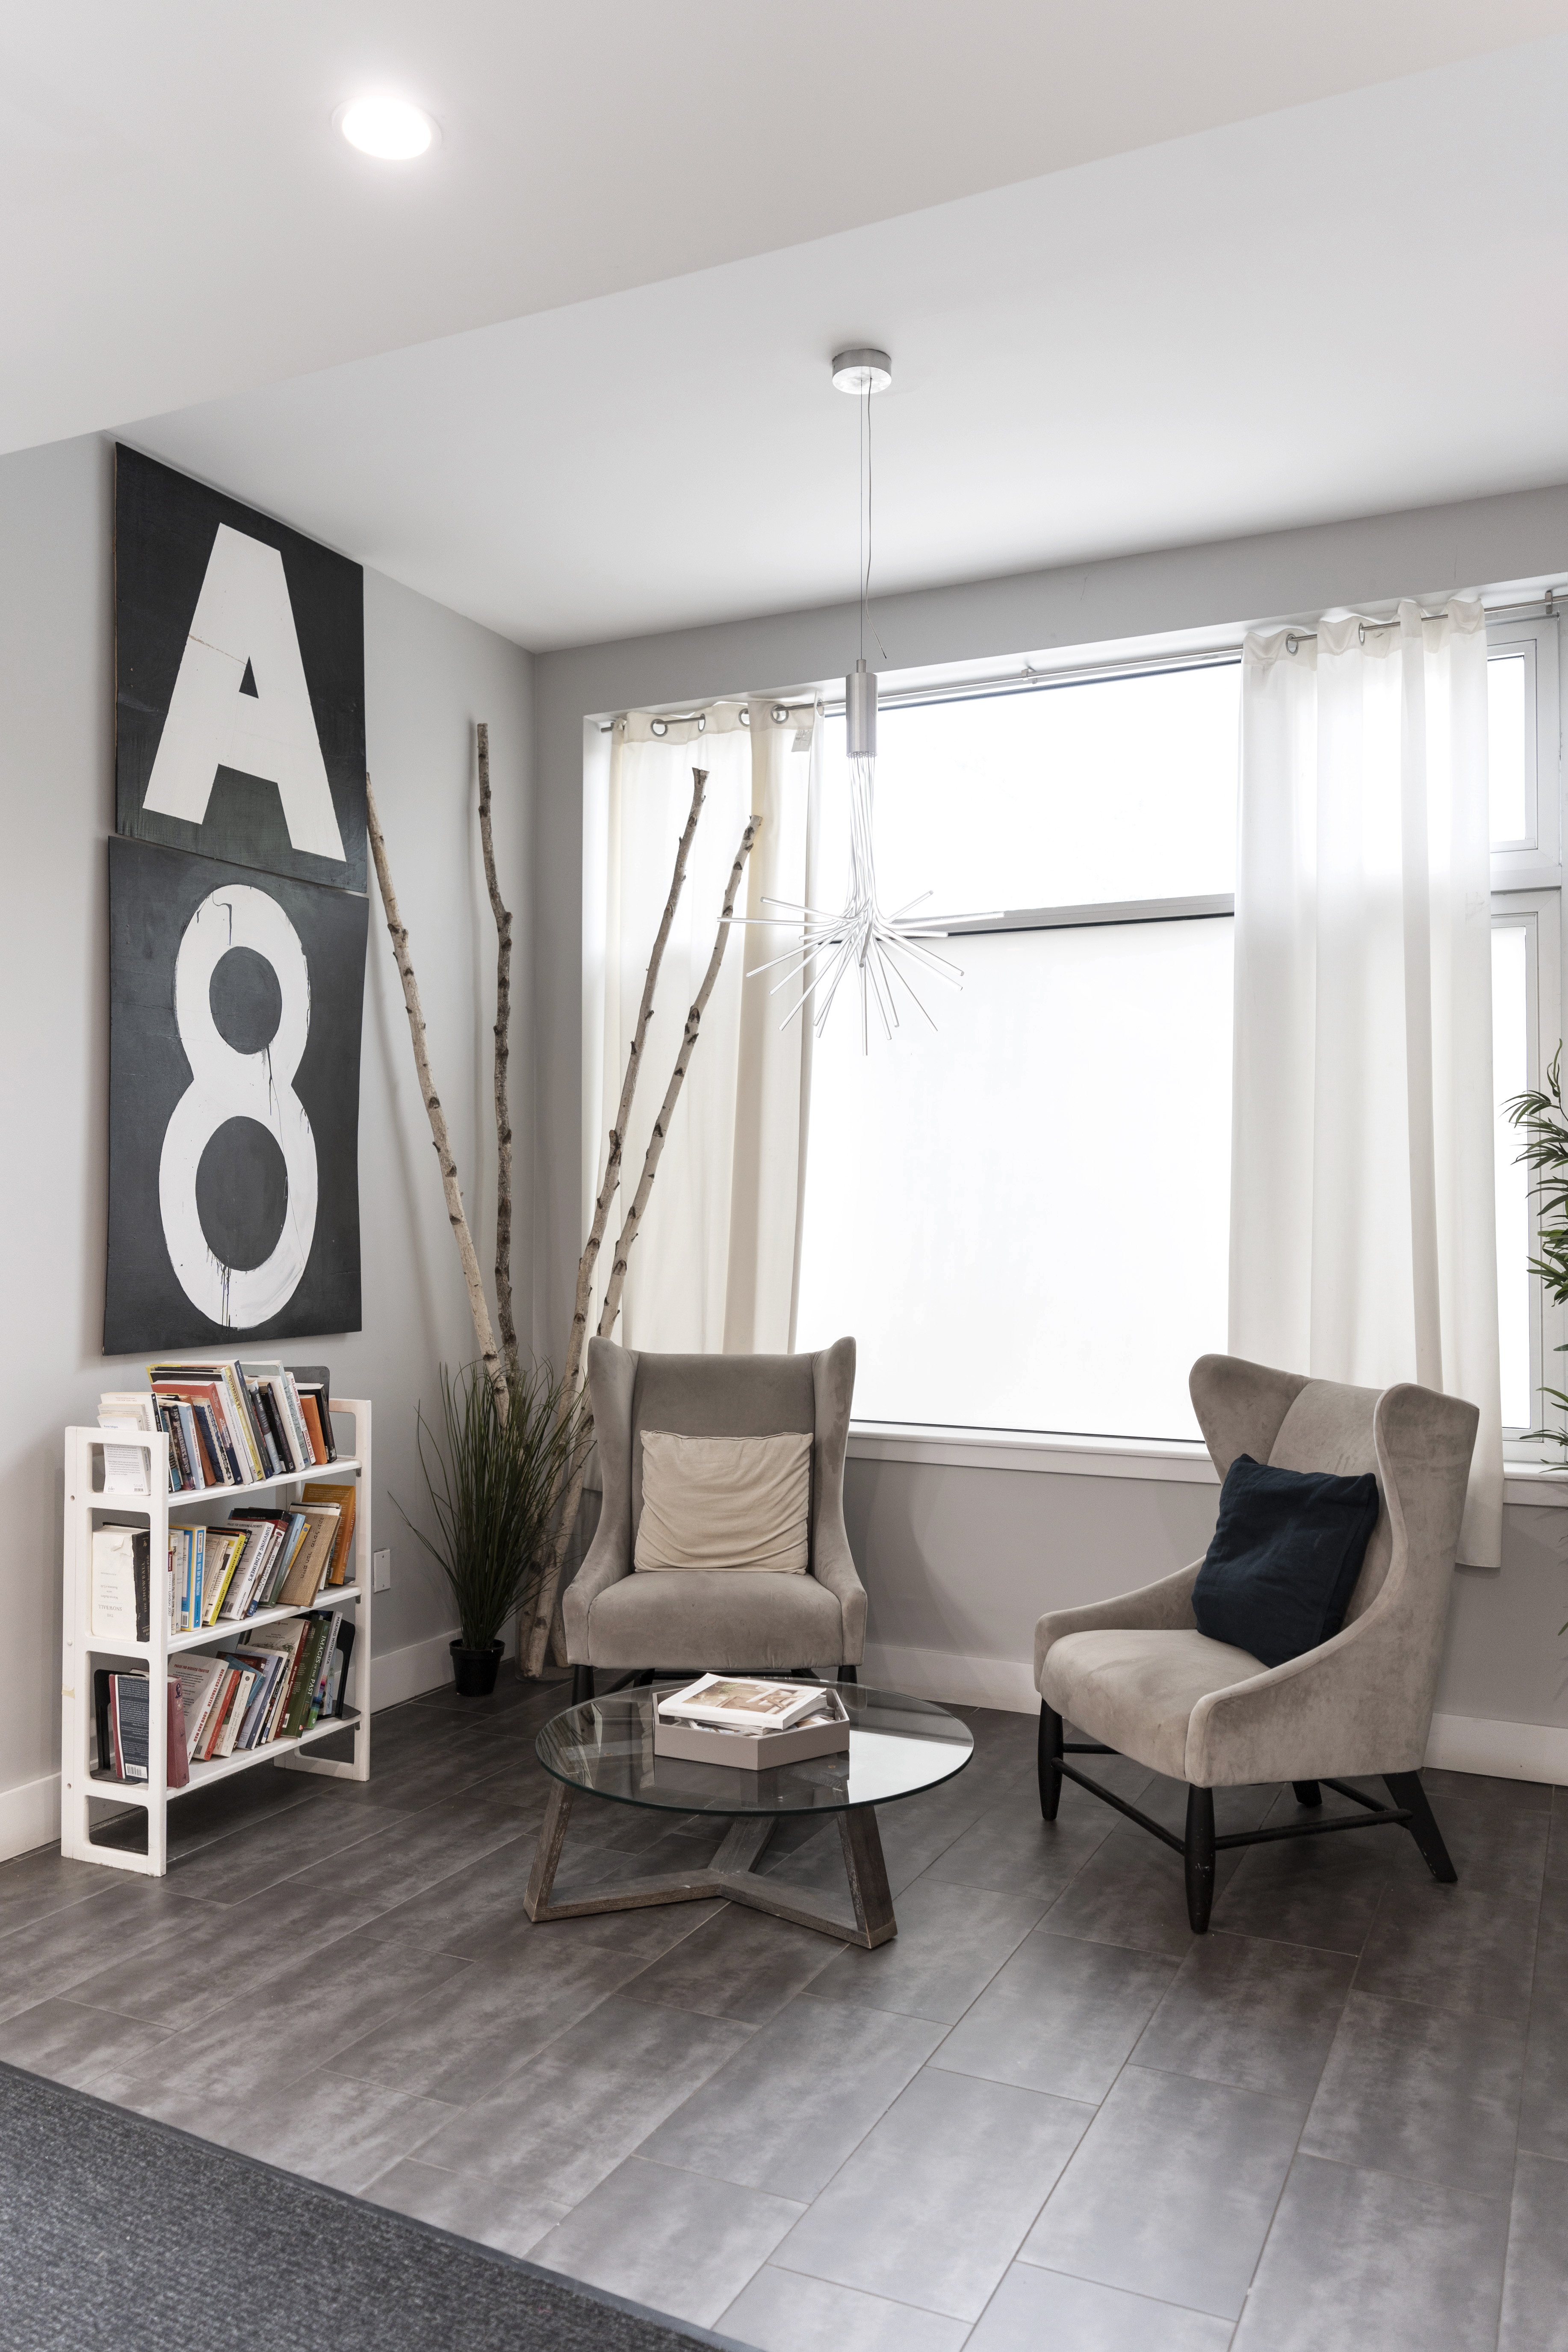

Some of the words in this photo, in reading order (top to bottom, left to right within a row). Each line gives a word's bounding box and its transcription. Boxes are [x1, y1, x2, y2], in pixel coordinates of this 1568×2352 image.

[142, 523, 346, 862] A
[159, 884, 318, 1329] 8
[227, 1374, 239, 1402] DECORACIÓN
[290, 1378, 299, 1402] ALEJANDRO
[259, 1526, 271, 1551] SURVIVING
[248, 1551, 262, 1582] ALZHEIMER'S
[332, 1616, 340, 1636] MAKING
[315, 1635, 326, 1663] IMAGES
[215, 1669, 224, 1687] REBECCA
[307, 1678, 315, 1696] PAST
[207, 1687, 217, 1707] TRAISTER
